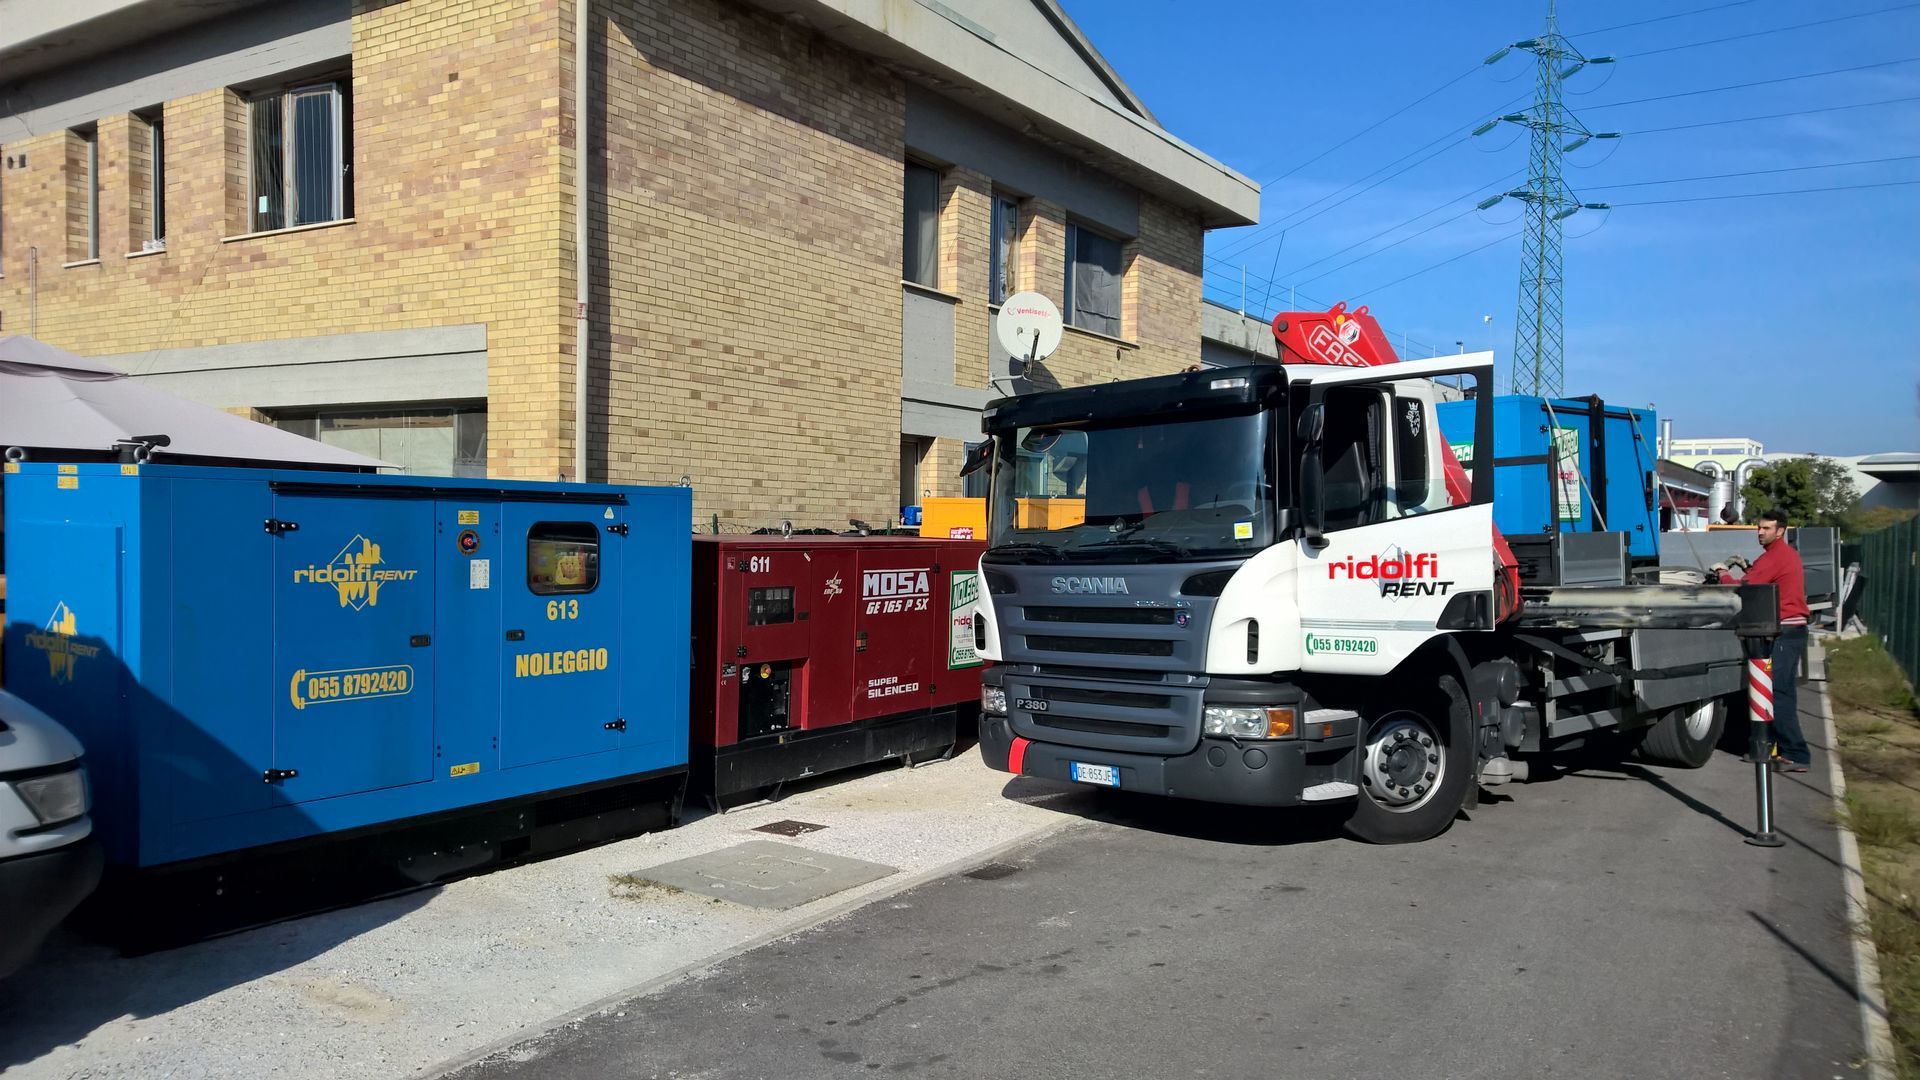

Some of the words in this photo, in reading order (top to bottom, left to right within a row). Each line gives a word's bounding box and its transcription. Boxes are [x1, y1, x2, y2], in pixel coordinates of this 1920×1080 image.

[750, 556, 770, 573] 611
[1328, 553, 1438, 580] ridolfi
[294, 564, 371, 584] ridolfi
[372, 570, 418, 581] RENT
[863, 572, 929, 596] MOSA
[1051, 576, 1129, 595] SCANIA
[1382, 581, 1455, 597] RENT
[547, 599, 579, 621] 613
[866, 601, 882, 615] GE
[882, 599, 903, 614] 165
[904, 599, 914, 612] P
[914, 598, 930, 611] SX
[1313, 638, 1331, 651] 055
[1334, 639, 1377, 653] 8792420
[515, 648, 609, 678] NOLEGGIO
[308, 677, 340, 699] 055
[343, 670, 407, 696] 8792420
[867, 682, 920, 699] SILENCED
[868, 676, 898, 688] SUPER
[1016, 699, 1024, 708] P
[1025, 700, 1047, 711] 380
